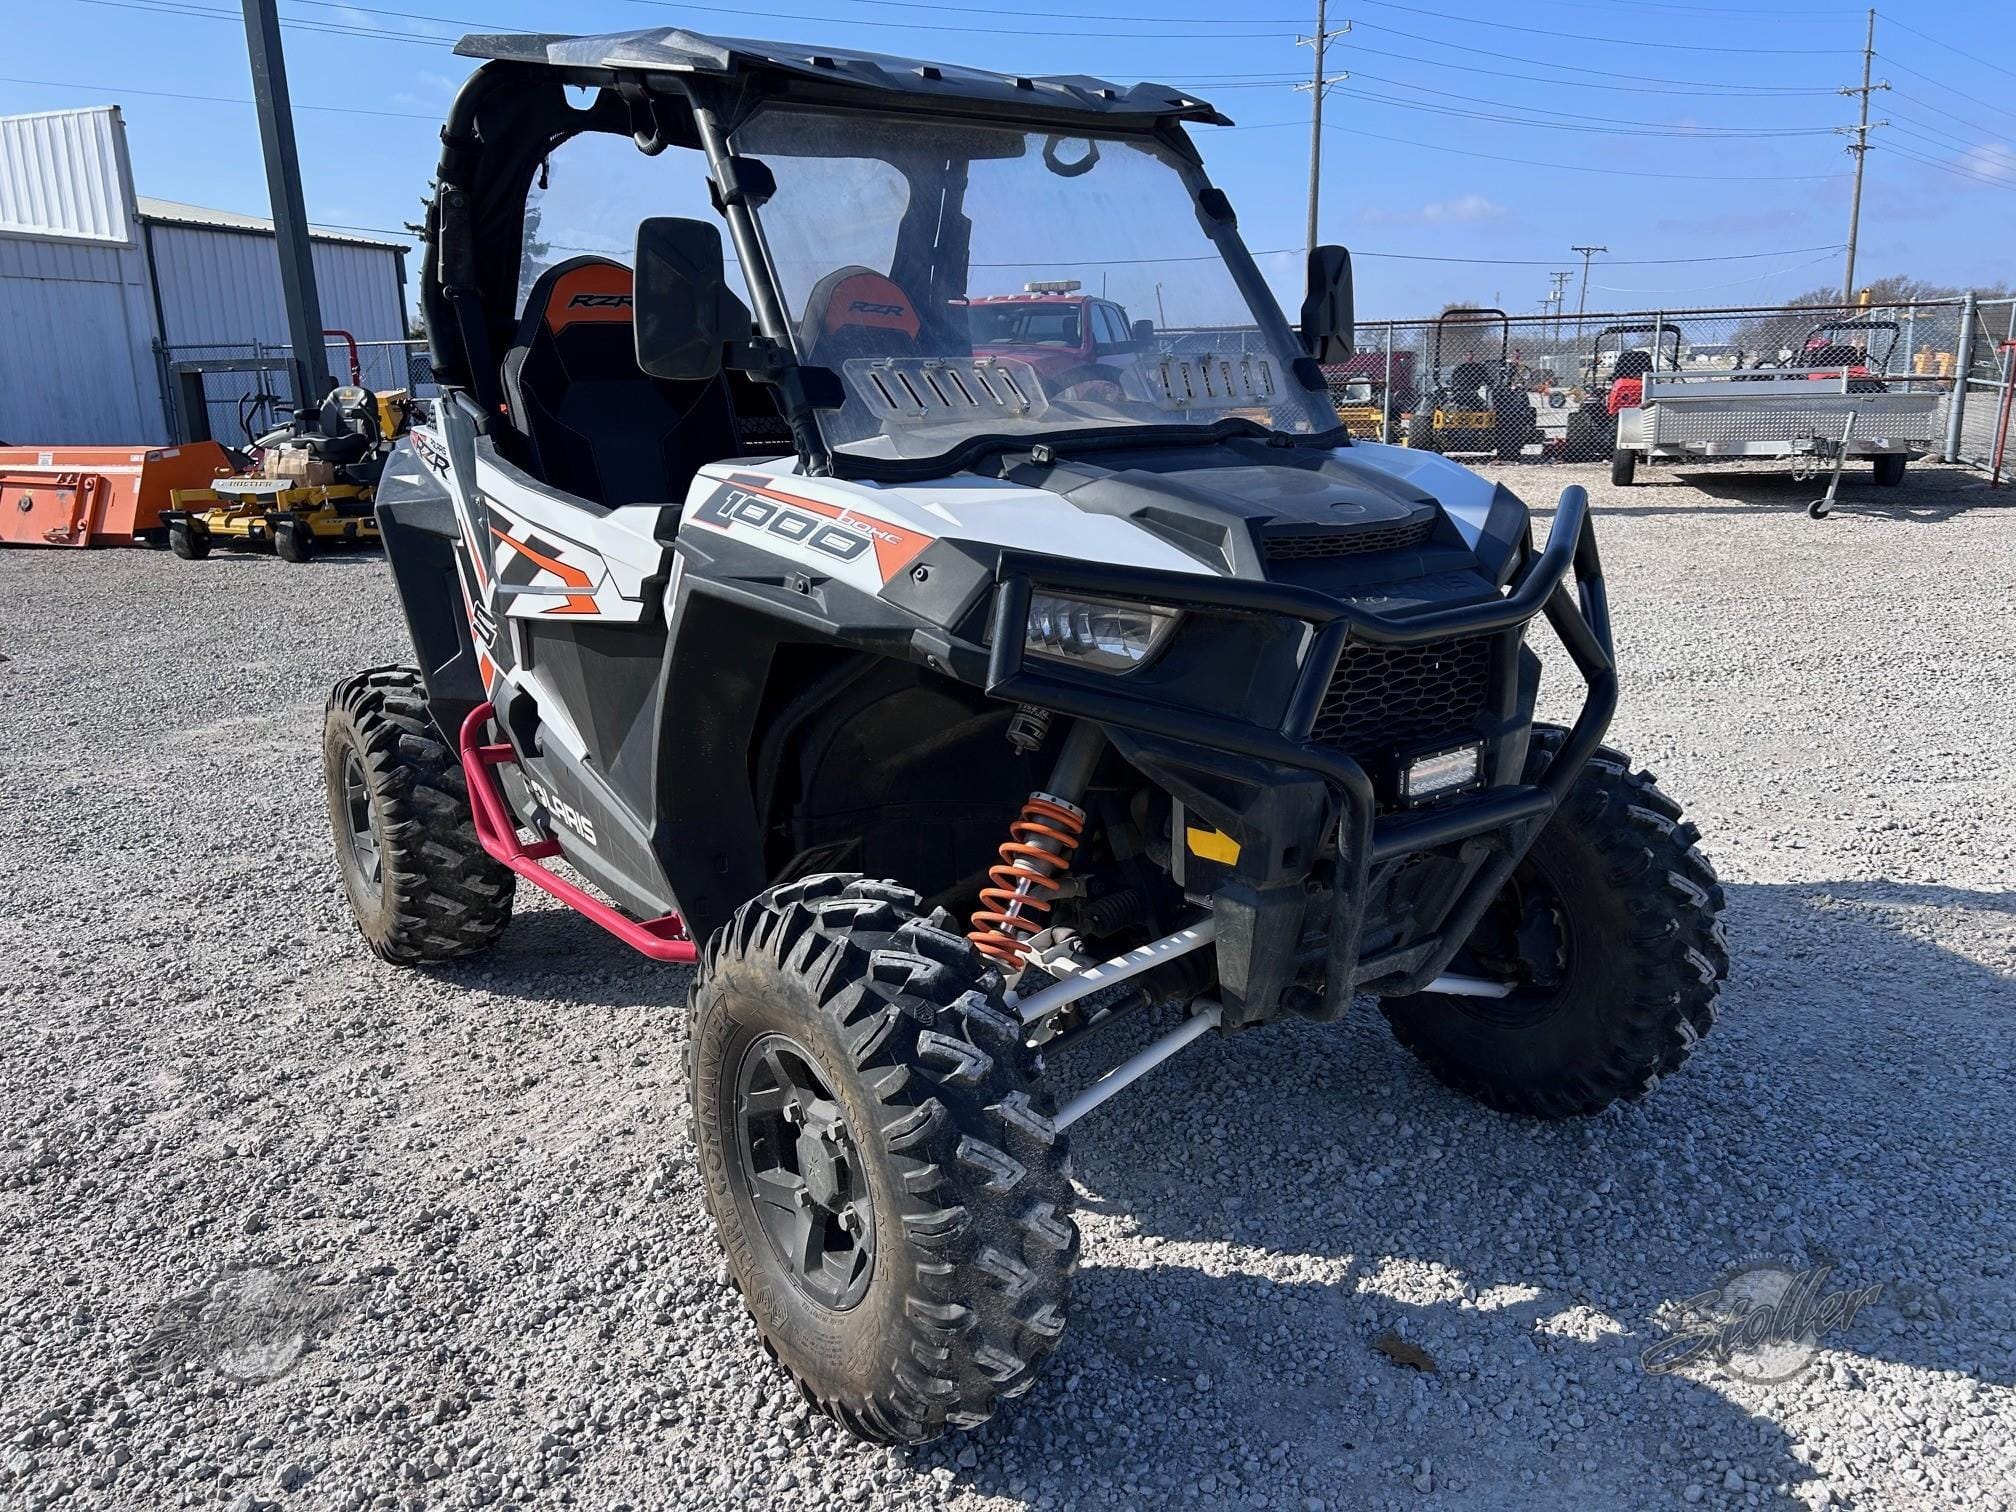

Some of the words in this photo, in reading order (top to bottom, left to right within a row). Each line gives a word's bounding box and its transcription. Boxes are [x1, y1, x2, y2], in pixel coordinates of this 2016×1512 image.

[847, 300, 905, 316] RZR
[717, 490, 874, 563] 1000
[523, 778, 598, 847] POLARIS
